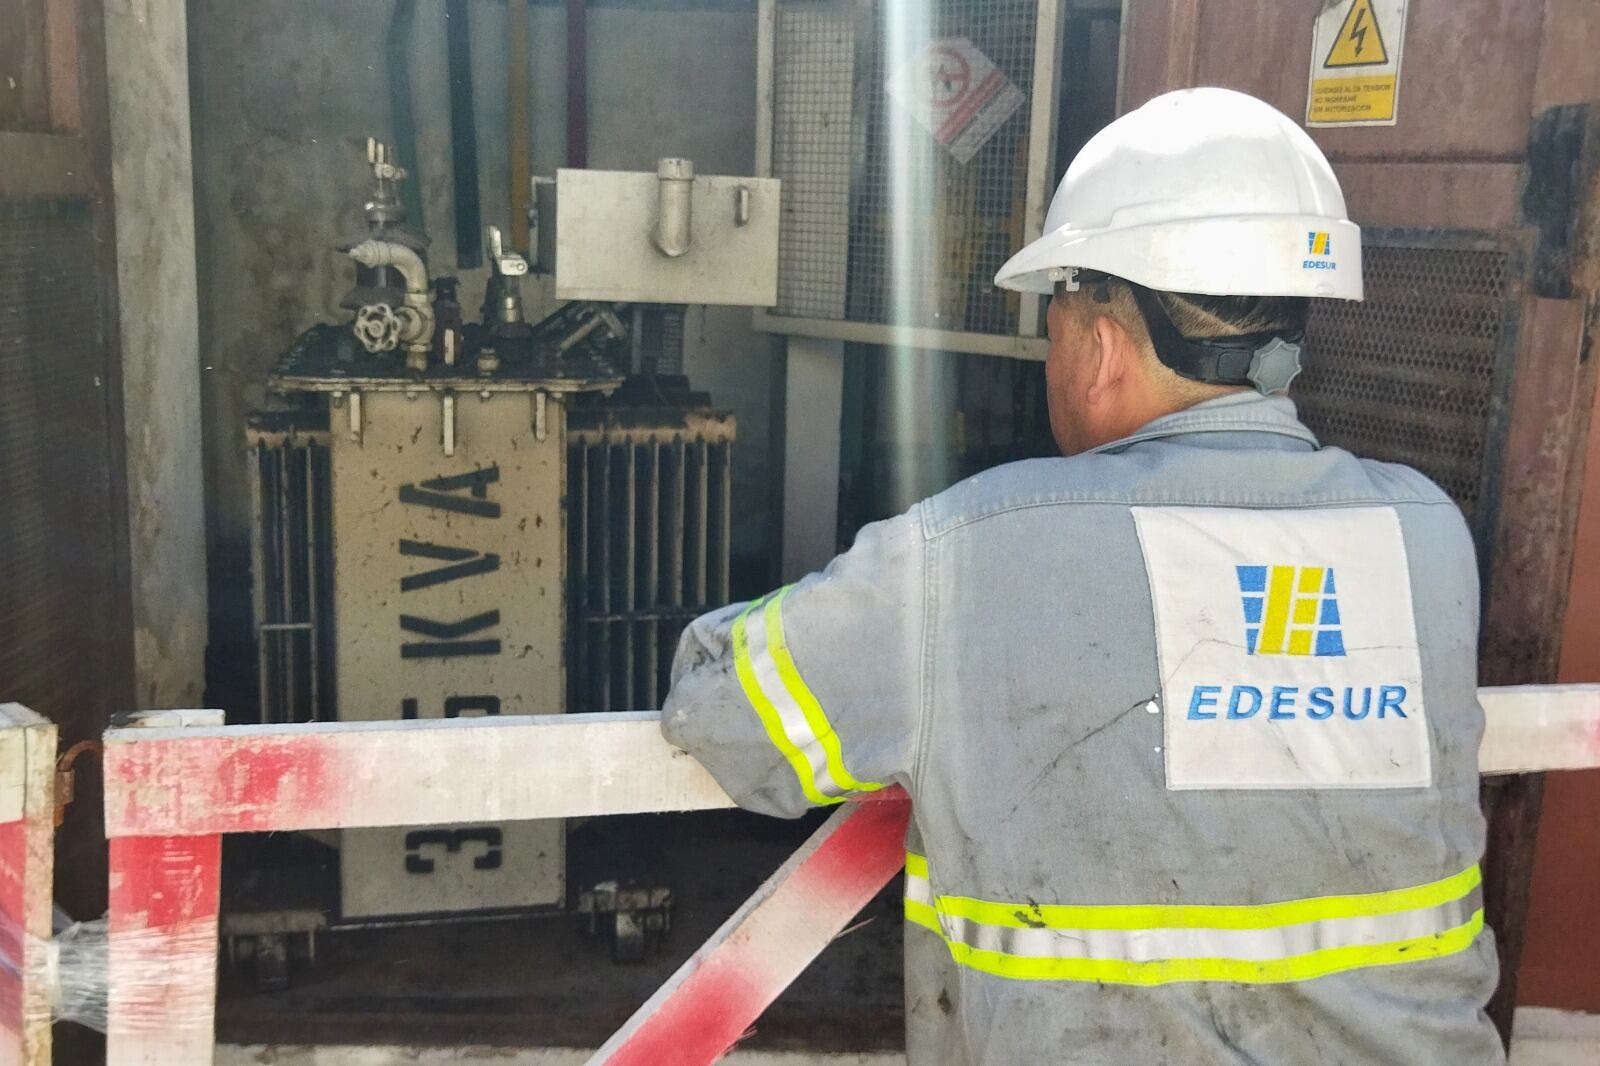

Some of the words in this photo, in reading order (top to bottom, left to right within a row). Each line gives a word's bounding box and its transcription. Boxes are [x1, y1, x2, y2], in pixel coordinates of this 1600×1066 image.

[1303, 260, 1337, 270] EDESUR
[400, 464, 500, 659] KVA
[1187, 685, 1408, 721] EDESUR
